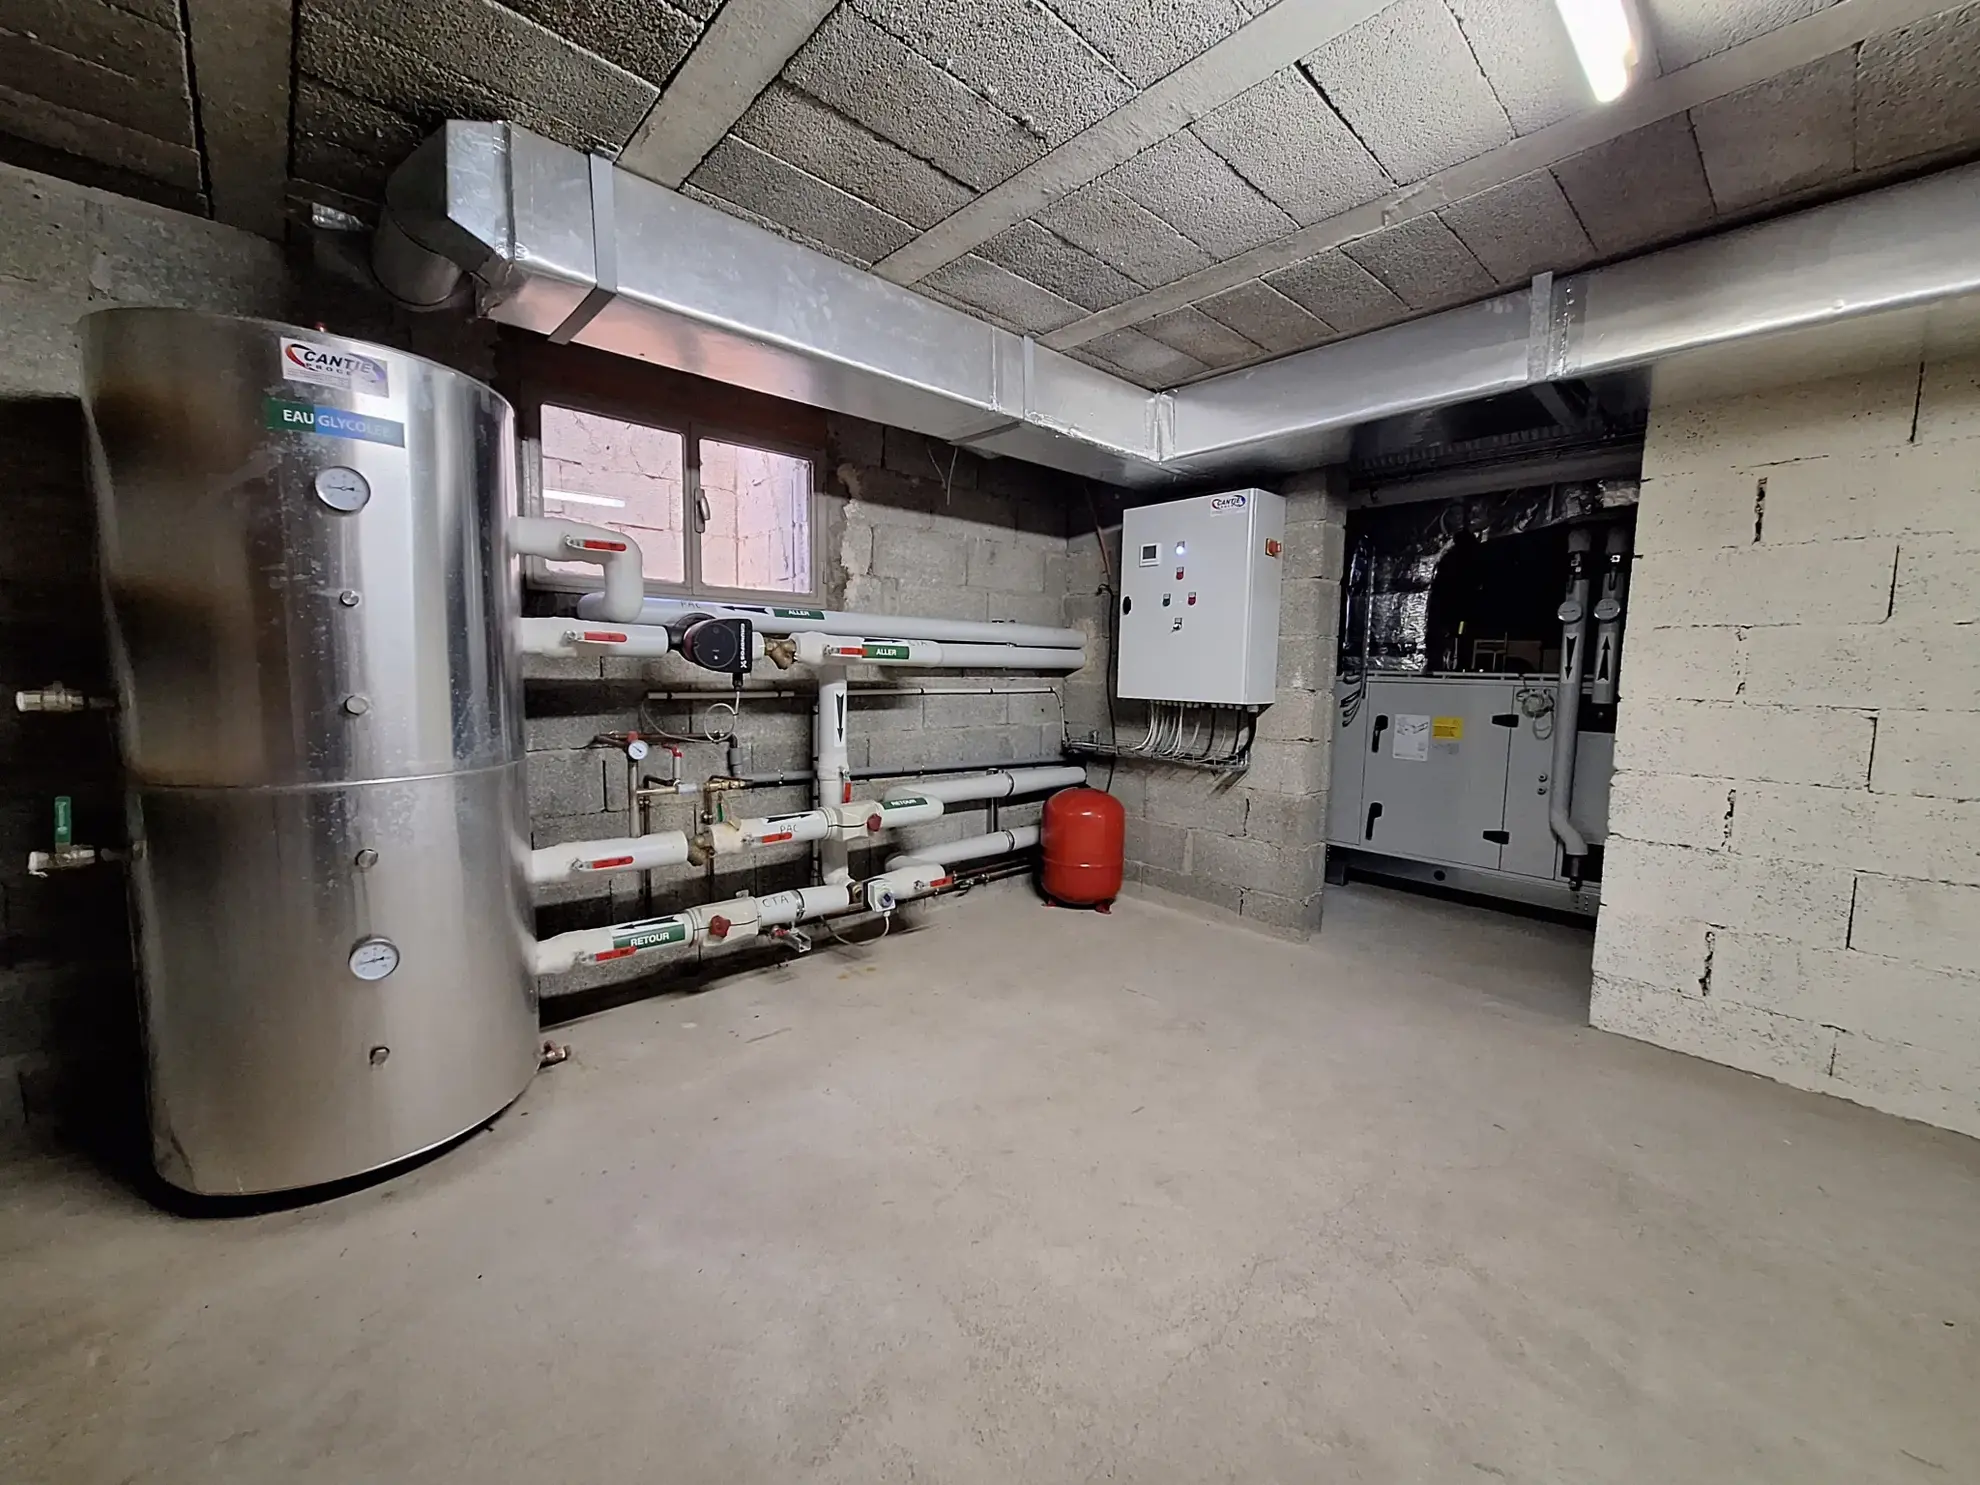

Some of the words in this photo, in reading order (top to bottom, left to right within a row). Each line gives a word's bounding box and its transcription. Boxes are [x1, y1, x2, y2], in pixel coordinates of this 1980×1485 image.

[283, 409, 314, 425] EAU
[876, 648, 897, 656] ALLER
[780, 824, 798, 834] PAC
[762, 895, 789, 907] CTA
[630, 932, 670, 946] RETOUR
